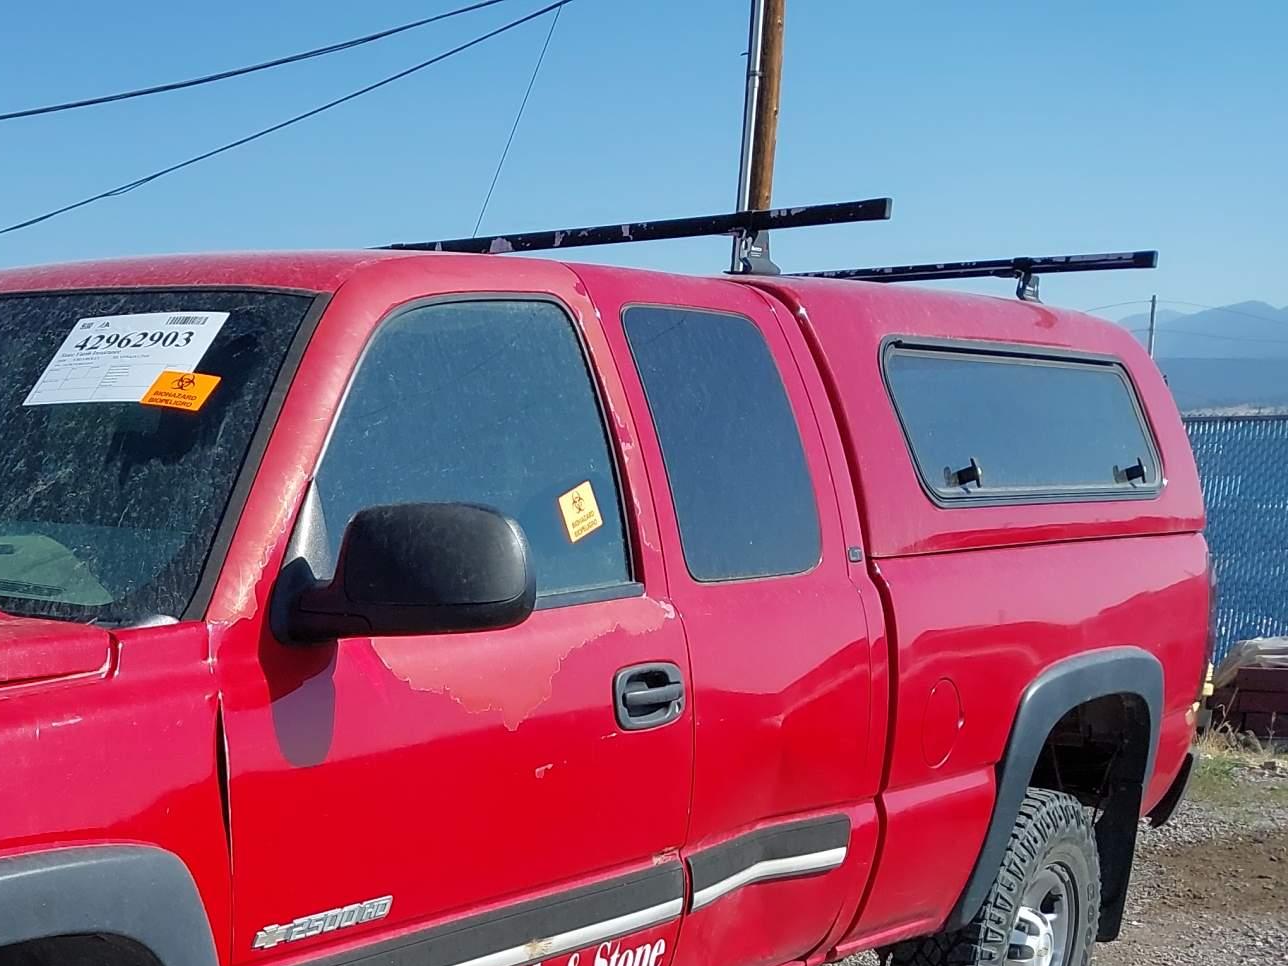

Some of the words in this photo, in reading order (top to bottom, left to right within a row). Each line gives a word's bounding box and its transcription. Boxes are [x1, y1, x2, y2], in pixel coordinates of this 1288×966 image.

[74, 331, 195, 352] 42962903
[153, 390, 197, 402] BIOHAZARD
[148, 397, 193, 408] BIOPELIGRO
